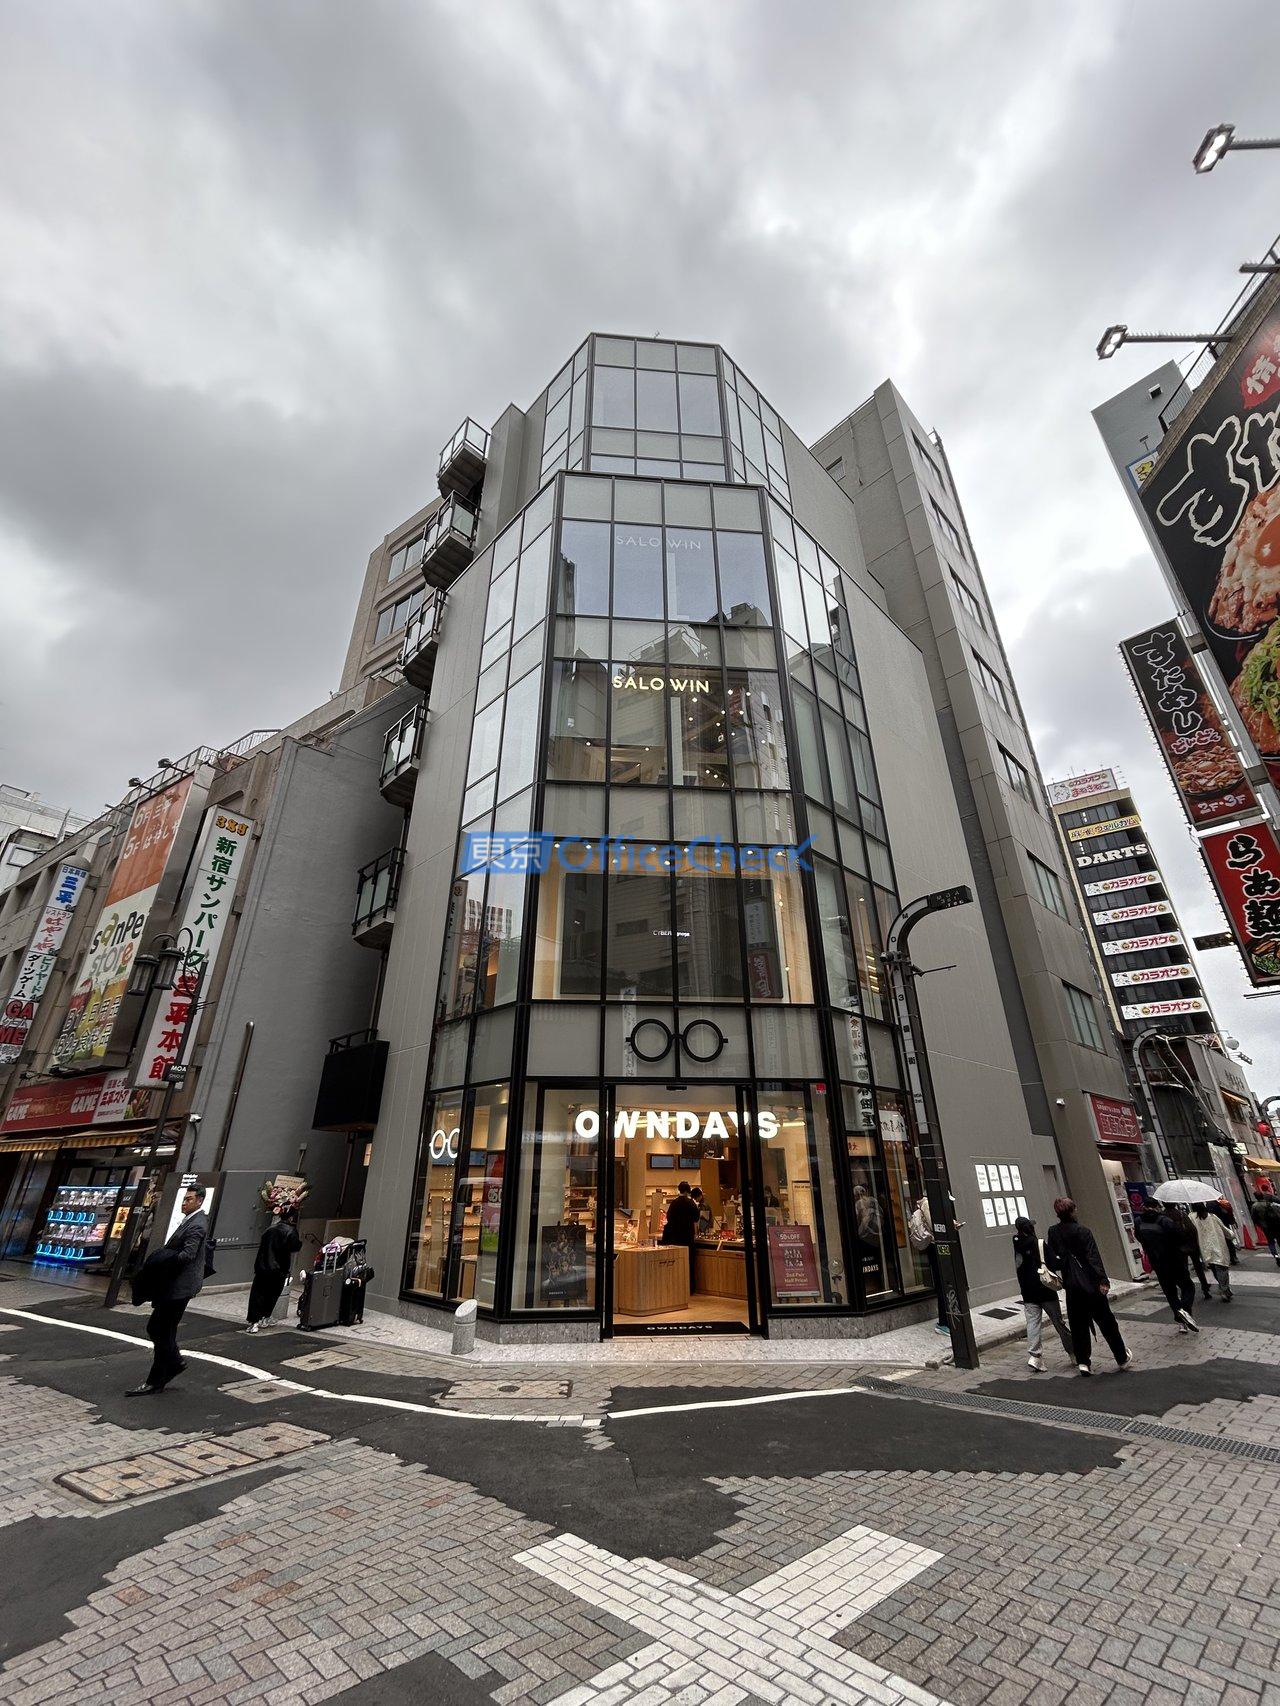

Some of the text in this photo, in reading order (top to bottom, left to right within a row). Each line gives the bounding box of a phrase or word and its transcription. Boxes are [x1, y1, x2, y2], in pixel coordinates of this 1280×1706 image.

[615, 535, 702, 551] SALO WIN
[612, 675, 710, 693] SALO WIN
[1076, 843, 1148, 867] DARTS
[55, 875, 79, 904] 三平
[1109, 874, 1147, 888] カラオケ
[186, 836, 237, 968] 新宿サンパーク
[1118, 905, 1158, 918] カラオケ
[46, 908, 73, 919] レストラン
[1128, 935, 1170, 949] カラオケ
[89, 942, 134, 977] store
[14, 954, 42, 999] ダーツゲーム
[31, 956, 53, 994] ビリヤード
[1139, 967, 1181, 981] カラオケ
[6, 1000, 34, 1020] GA
[1150, 1001, 1192, 1014] カラオケ
[0, 1025, 28, 1046] ME
[71, 1094, 100, 1114] GAME
[575, 1110, 780, 1139] OWNDAYS
